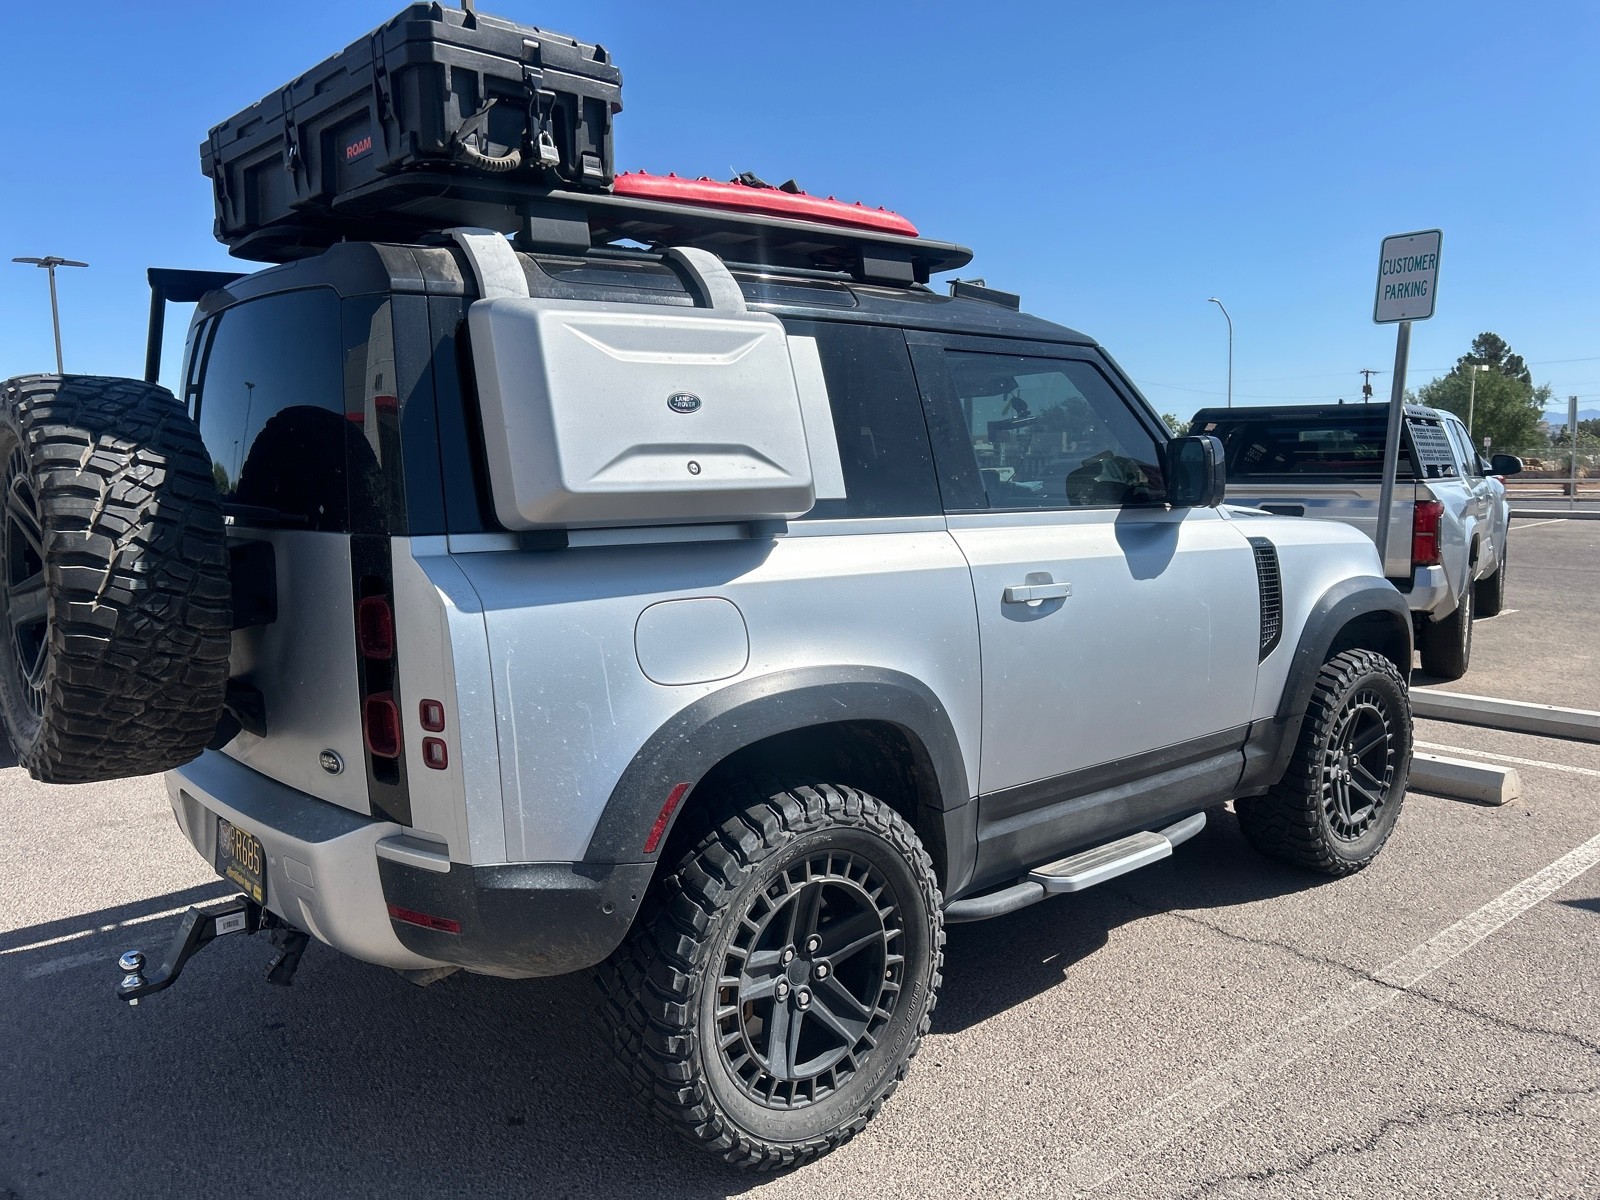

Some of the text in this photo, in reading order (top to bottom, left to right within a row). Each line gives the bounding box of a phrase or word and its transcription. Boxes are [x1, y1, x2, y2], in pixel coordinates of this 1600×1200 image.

[346, 135, 372, 159] ROAM
[1382, 253, 1436, 276] CUSTOMER
[1384, 280, 1428, 300] PARKING
